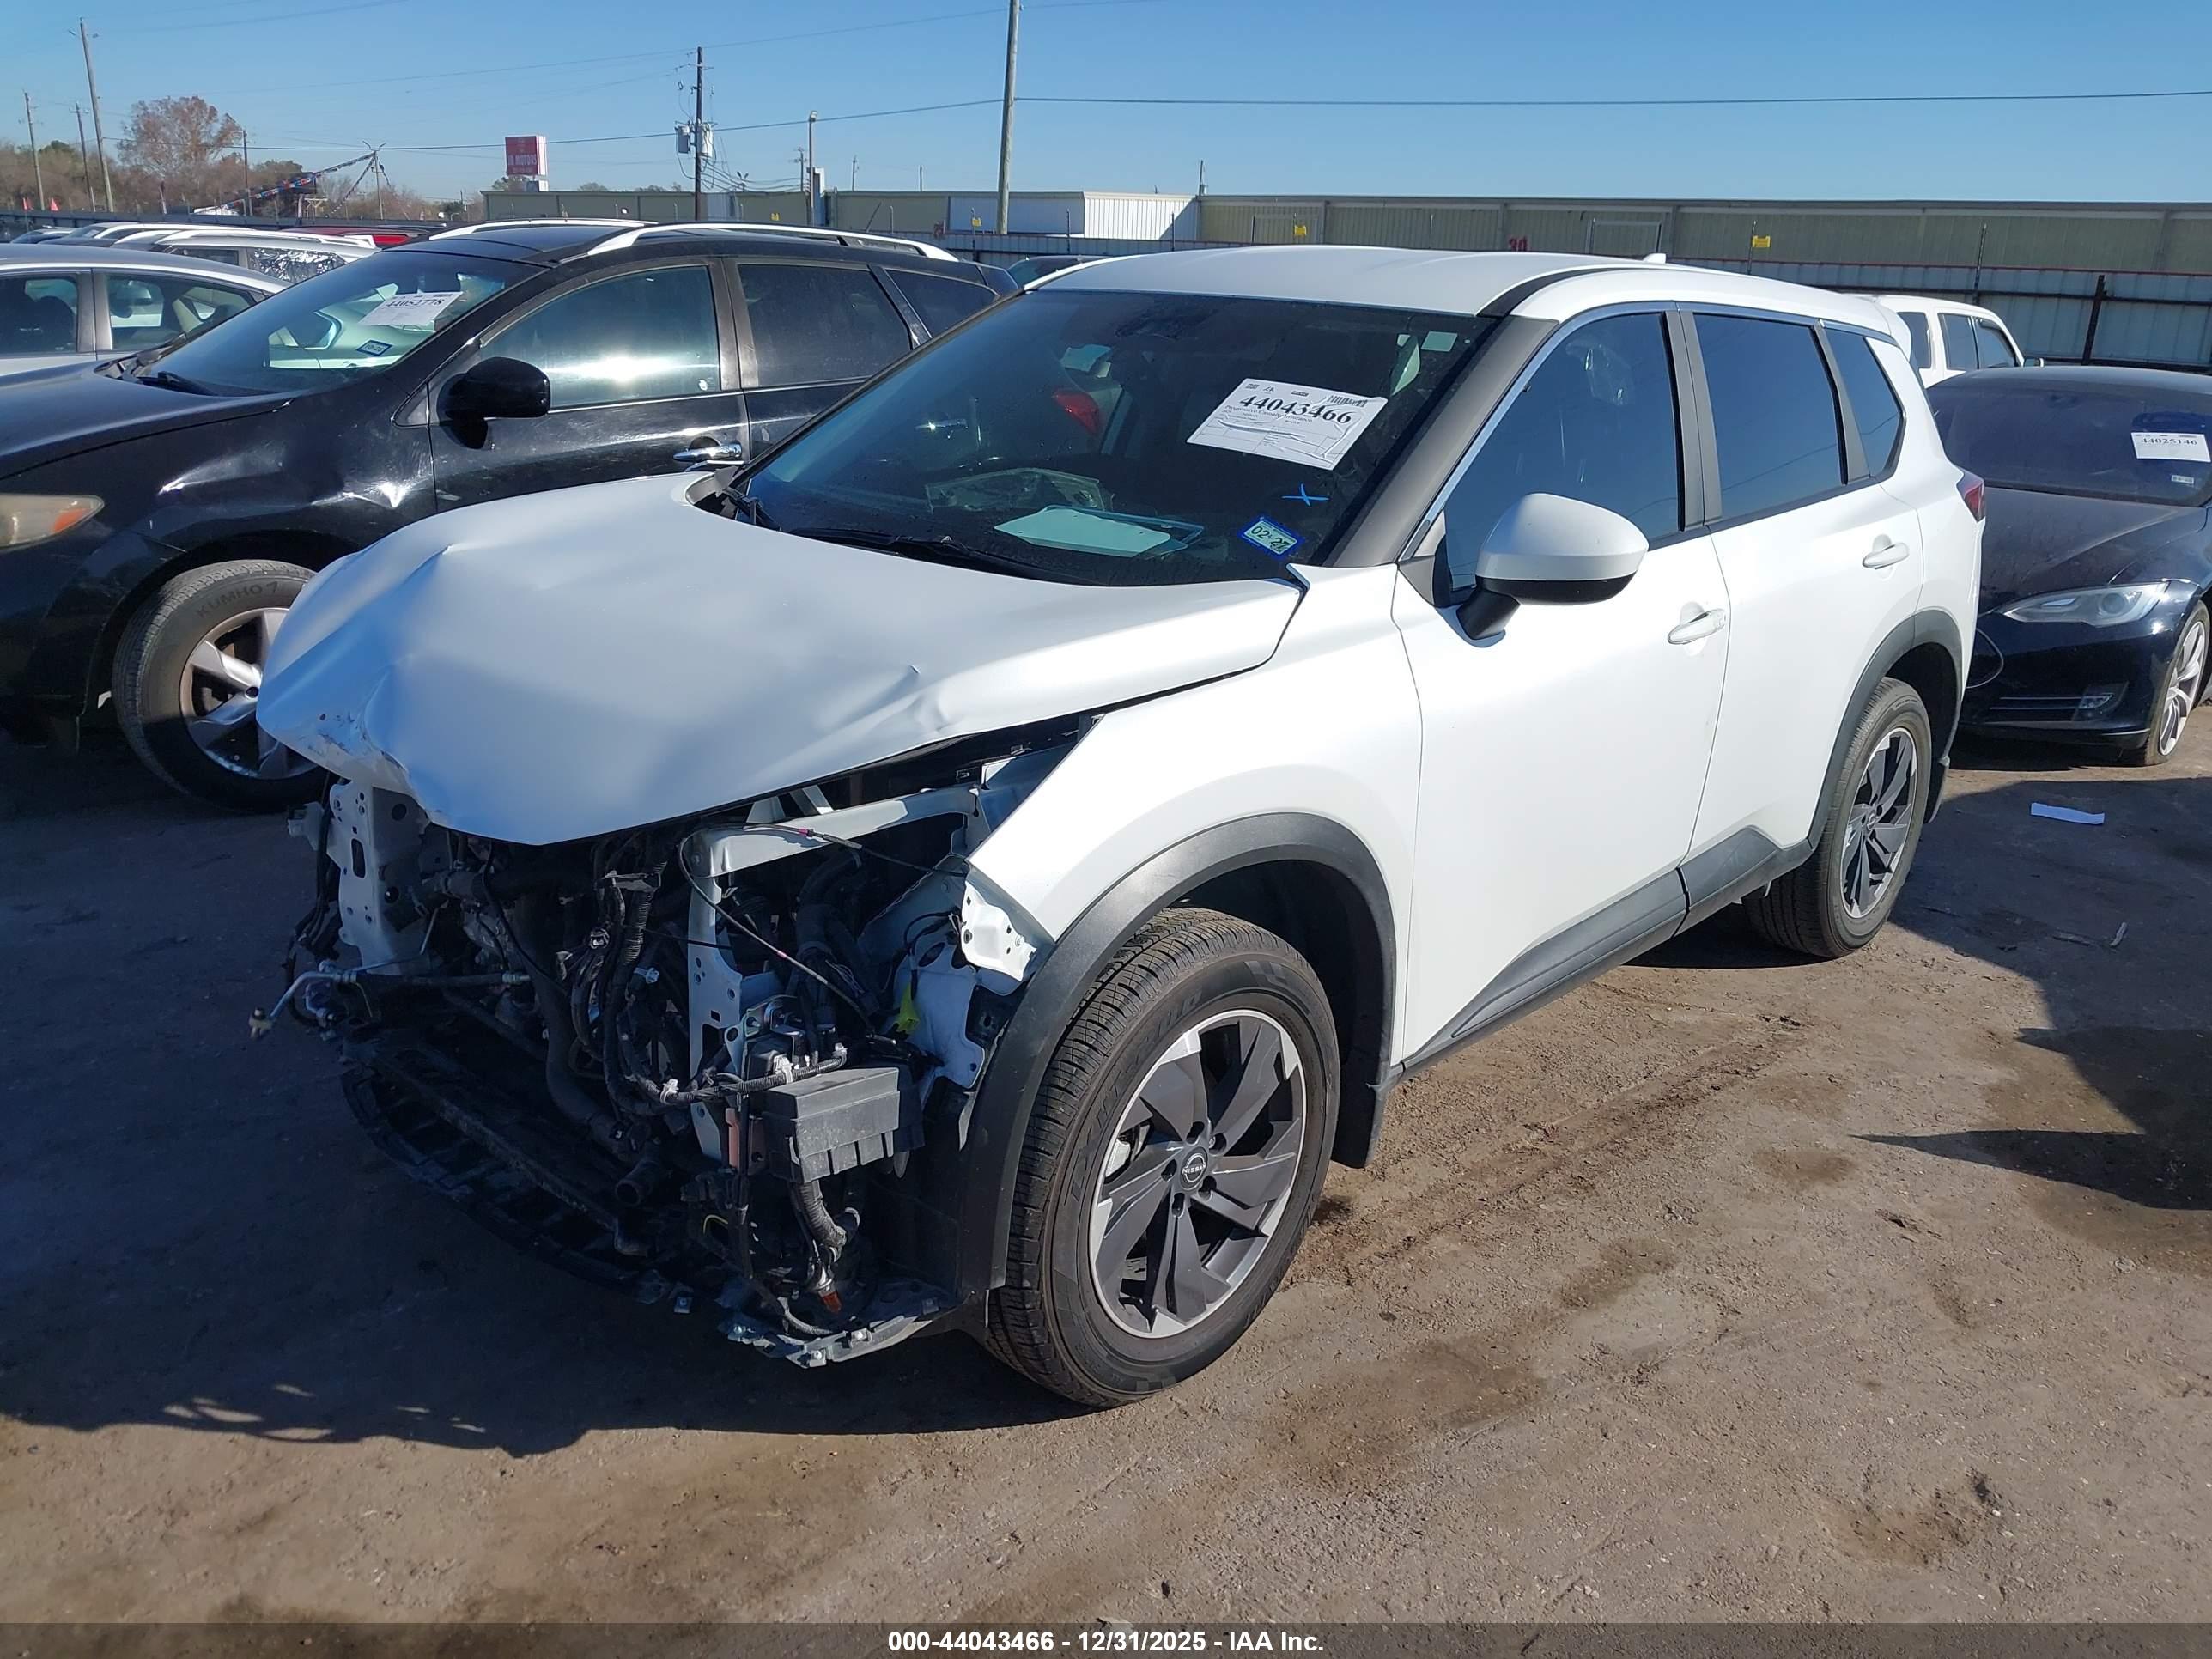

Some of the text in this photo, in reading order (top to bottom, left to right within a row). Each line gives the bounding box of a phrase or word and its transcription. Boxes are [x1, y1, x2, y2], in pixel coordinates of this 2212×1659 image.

[1240, 396, 1352, 423] 44043466
[2141, 437, 2198, 446] 44025146
[1251, 526, 1270, 539] 02
[1182, 1163, 1206, 1175] NISSAN
